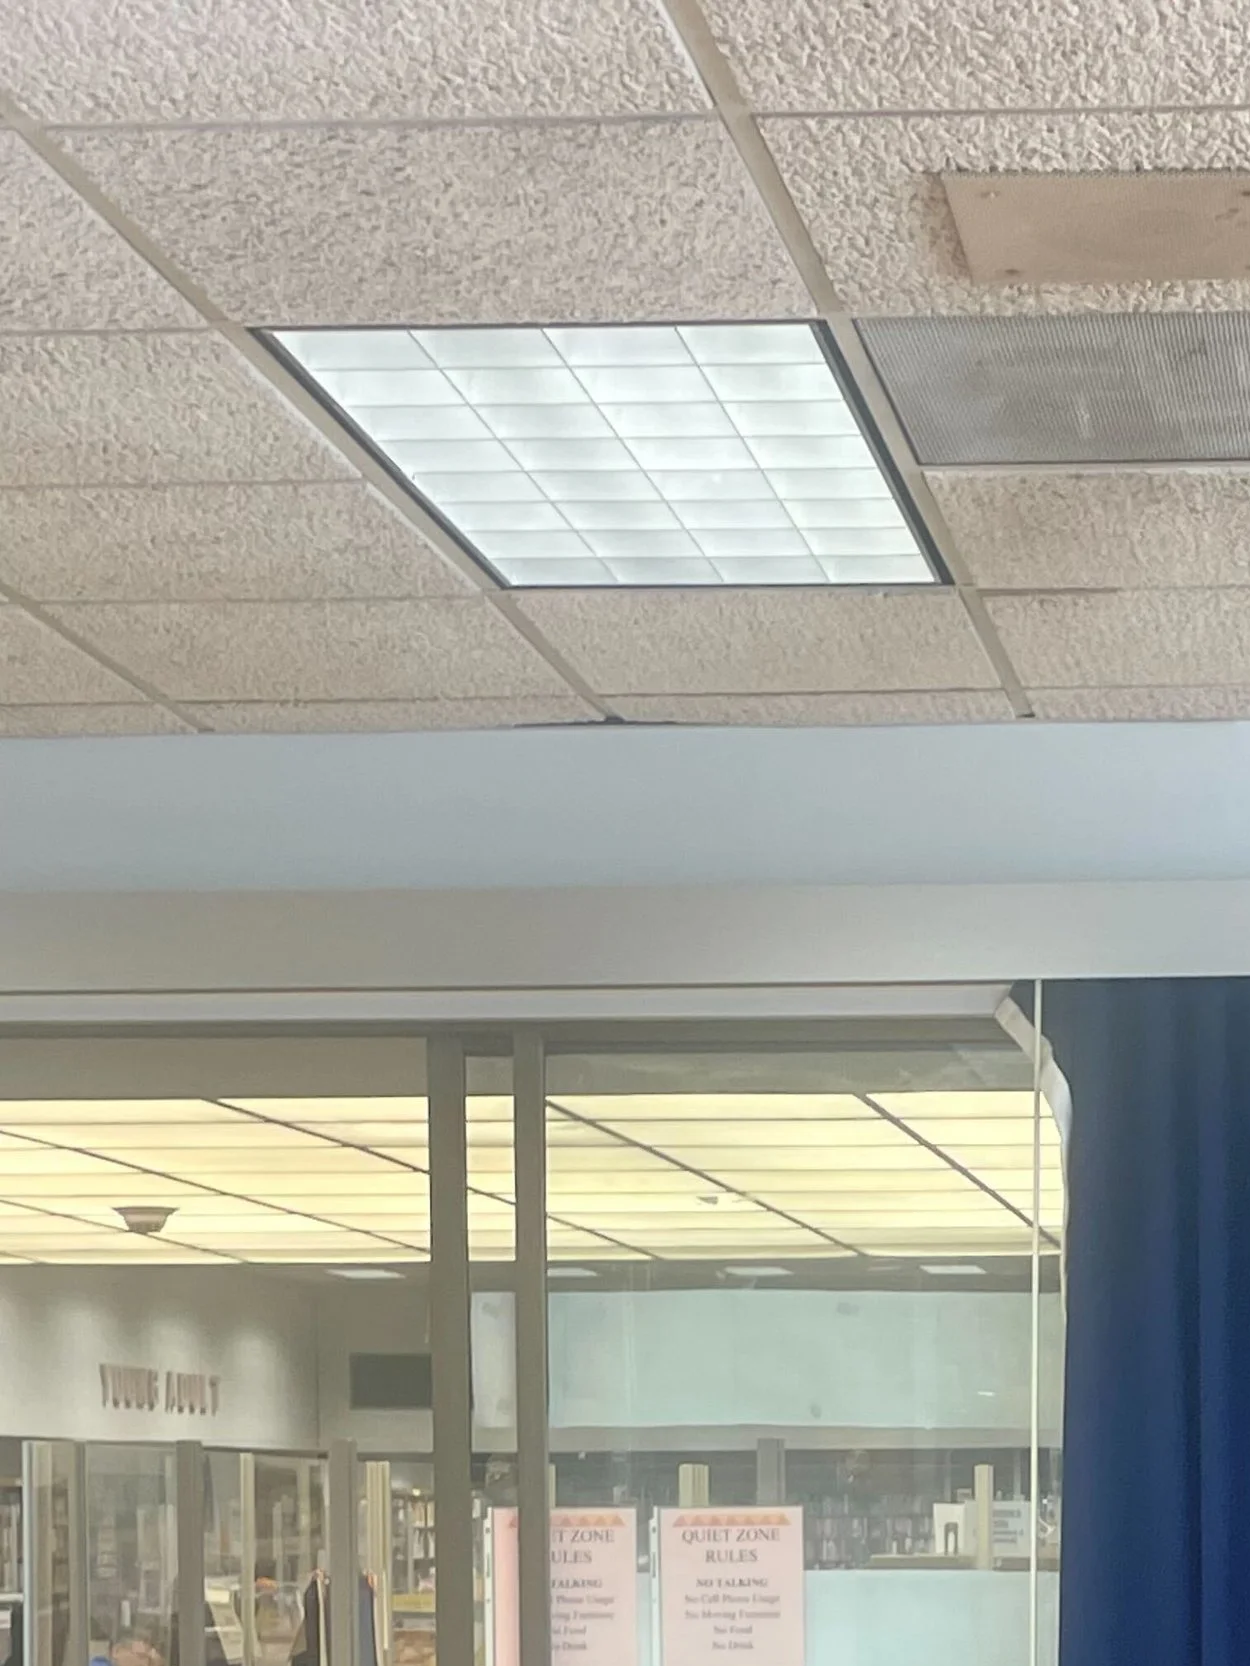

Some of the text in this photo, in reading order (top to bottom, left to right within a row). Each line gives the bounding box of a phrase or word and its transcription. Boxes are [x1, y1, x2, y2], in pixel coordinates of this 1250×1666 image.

[571, 1529, 615, 1543] ZONE
[681, 1527, 781, 1545] QUIET ZONE
[551, 1550, 592, 1564] ULES
[705, 1548, 759, 1563] RULES
[696, 1578, 768, 1588] NO TALKING
